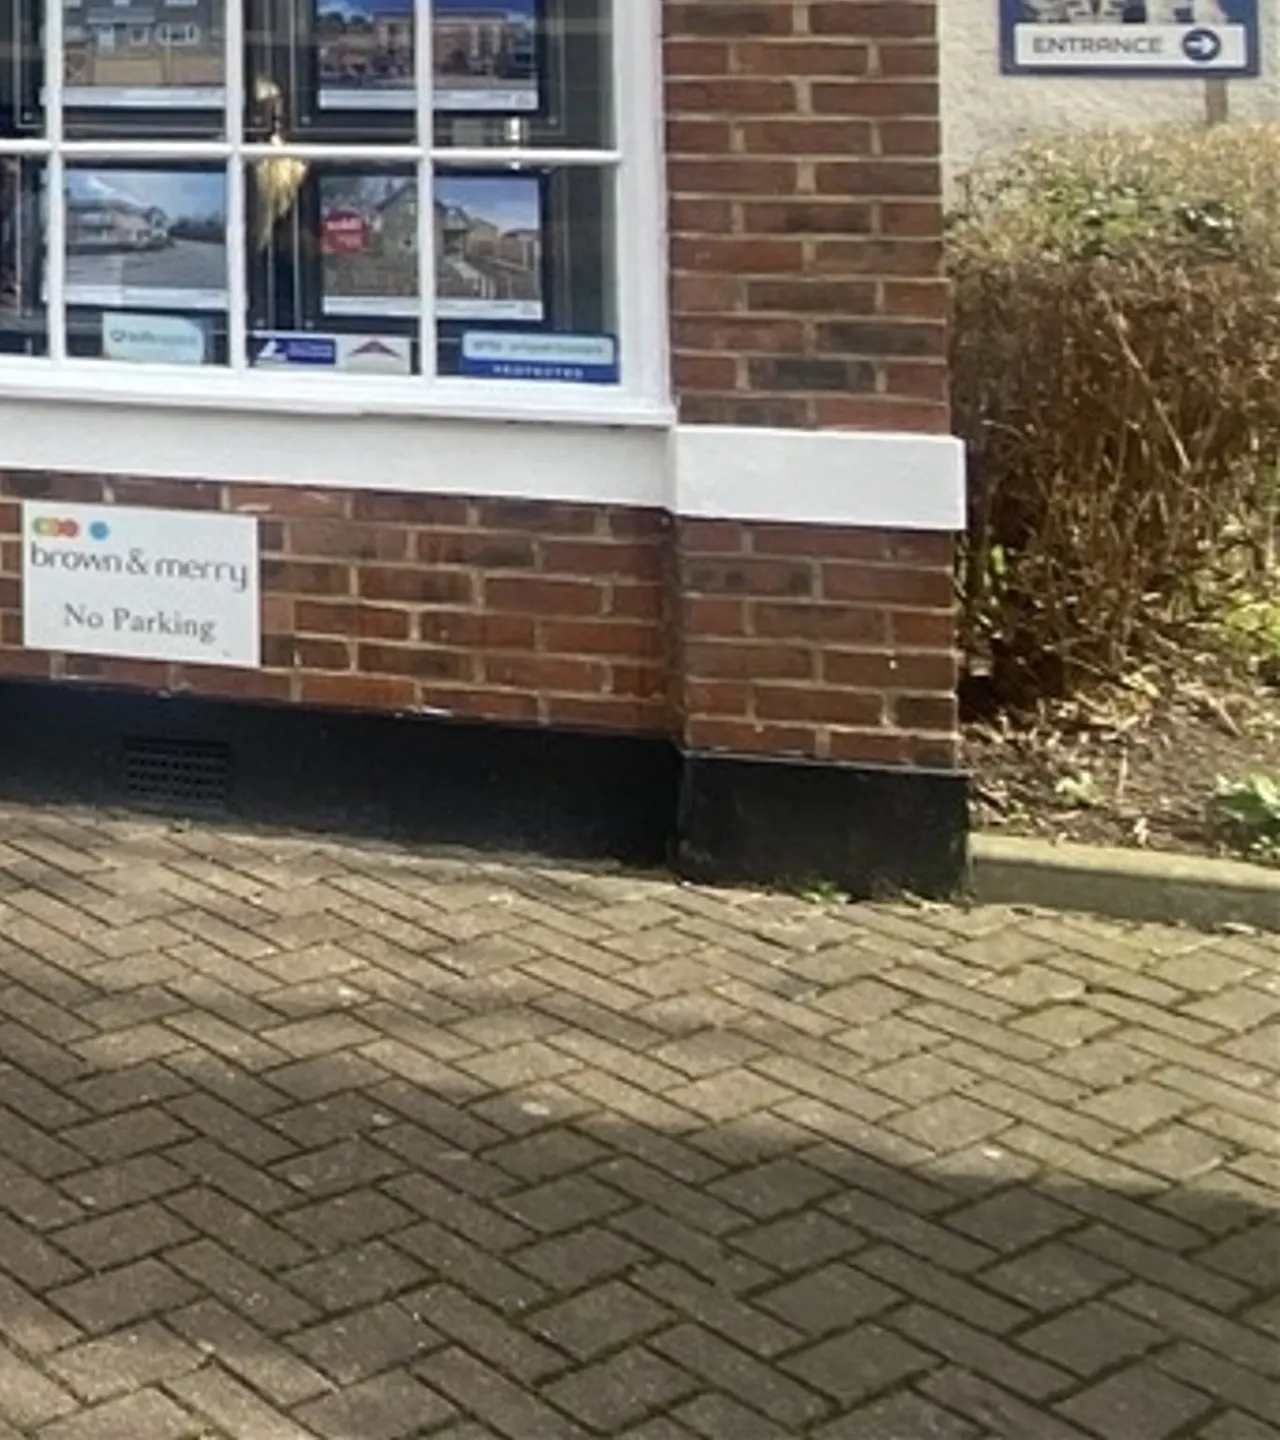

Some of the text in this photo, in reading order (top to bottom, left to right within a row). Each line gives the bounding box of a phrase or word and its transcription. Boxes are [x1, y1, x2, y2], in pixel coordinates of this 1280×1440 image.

[1032, 34, 1164, 56] ENTRANCE
[30, 542, 249, 592] brown & merry
[63, 603, 217, 642] No Parking
